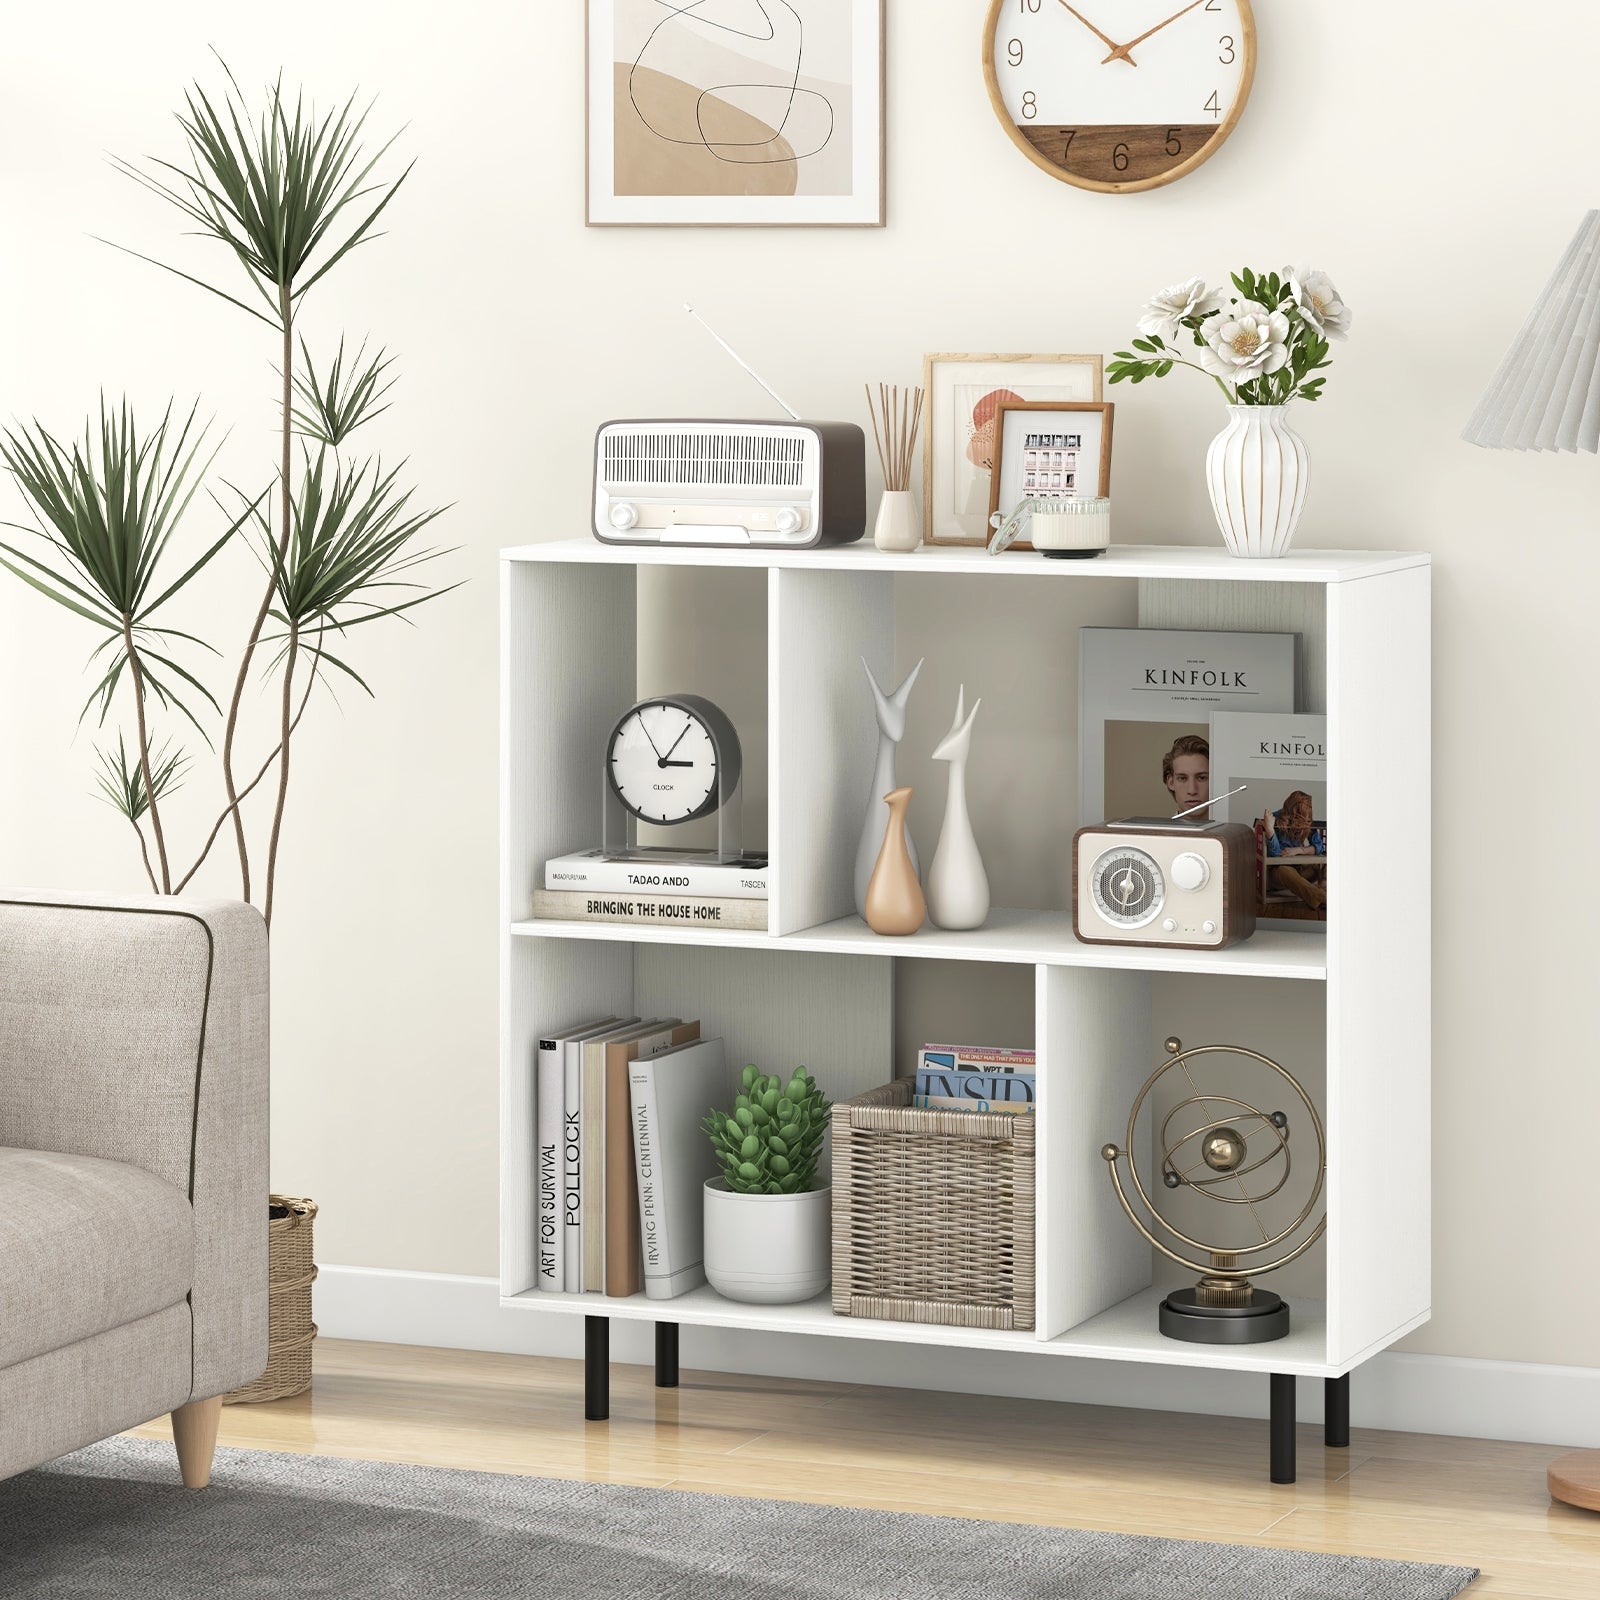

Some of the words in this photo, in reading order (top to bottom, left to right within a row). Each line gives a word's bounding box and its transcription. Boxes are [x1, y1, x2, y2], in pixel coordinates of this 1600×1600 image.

[1007, 38, 1024, 67] 9
[1218, 35, 1236, 64] 3
[1021, 91, 1038, 119] 8
[1203, 89, 1222, 118] 4
[1059, 129, 1078, 159] 7
[1164, 128, 1182, 156] 5
[1112, 143, 1130, 171] 6
[1145, 669, 1247, 687] KINFOLK
[652, 784, 675, 792] CLOCK
[627, 873, 661, 887] TADAO
[662, 875, 690, 888] ANDO
[587, 900, 634, 917] BRINGING
[636, 903, 656, 918] THE
[657, 904, 691, 920] HOUSE
[693, 905, 721, 921] HOME
[983, 1065, 1003, 1074] WPT
[920, 1073, 1036, 1103] INSID
[637, 1103, 653, 1178] CENTENNIAL
[541, 1144, 556, 1210] SURVIVAL
[565, 1110, 581, 1227] POLLOCK
[642, 1182, 656, 1217] PENN:
[541, 1215, 556, 1245] FOR
[645, 1220, 660, 1266] IRVING
[541, 1250, 556, 1278] ART
